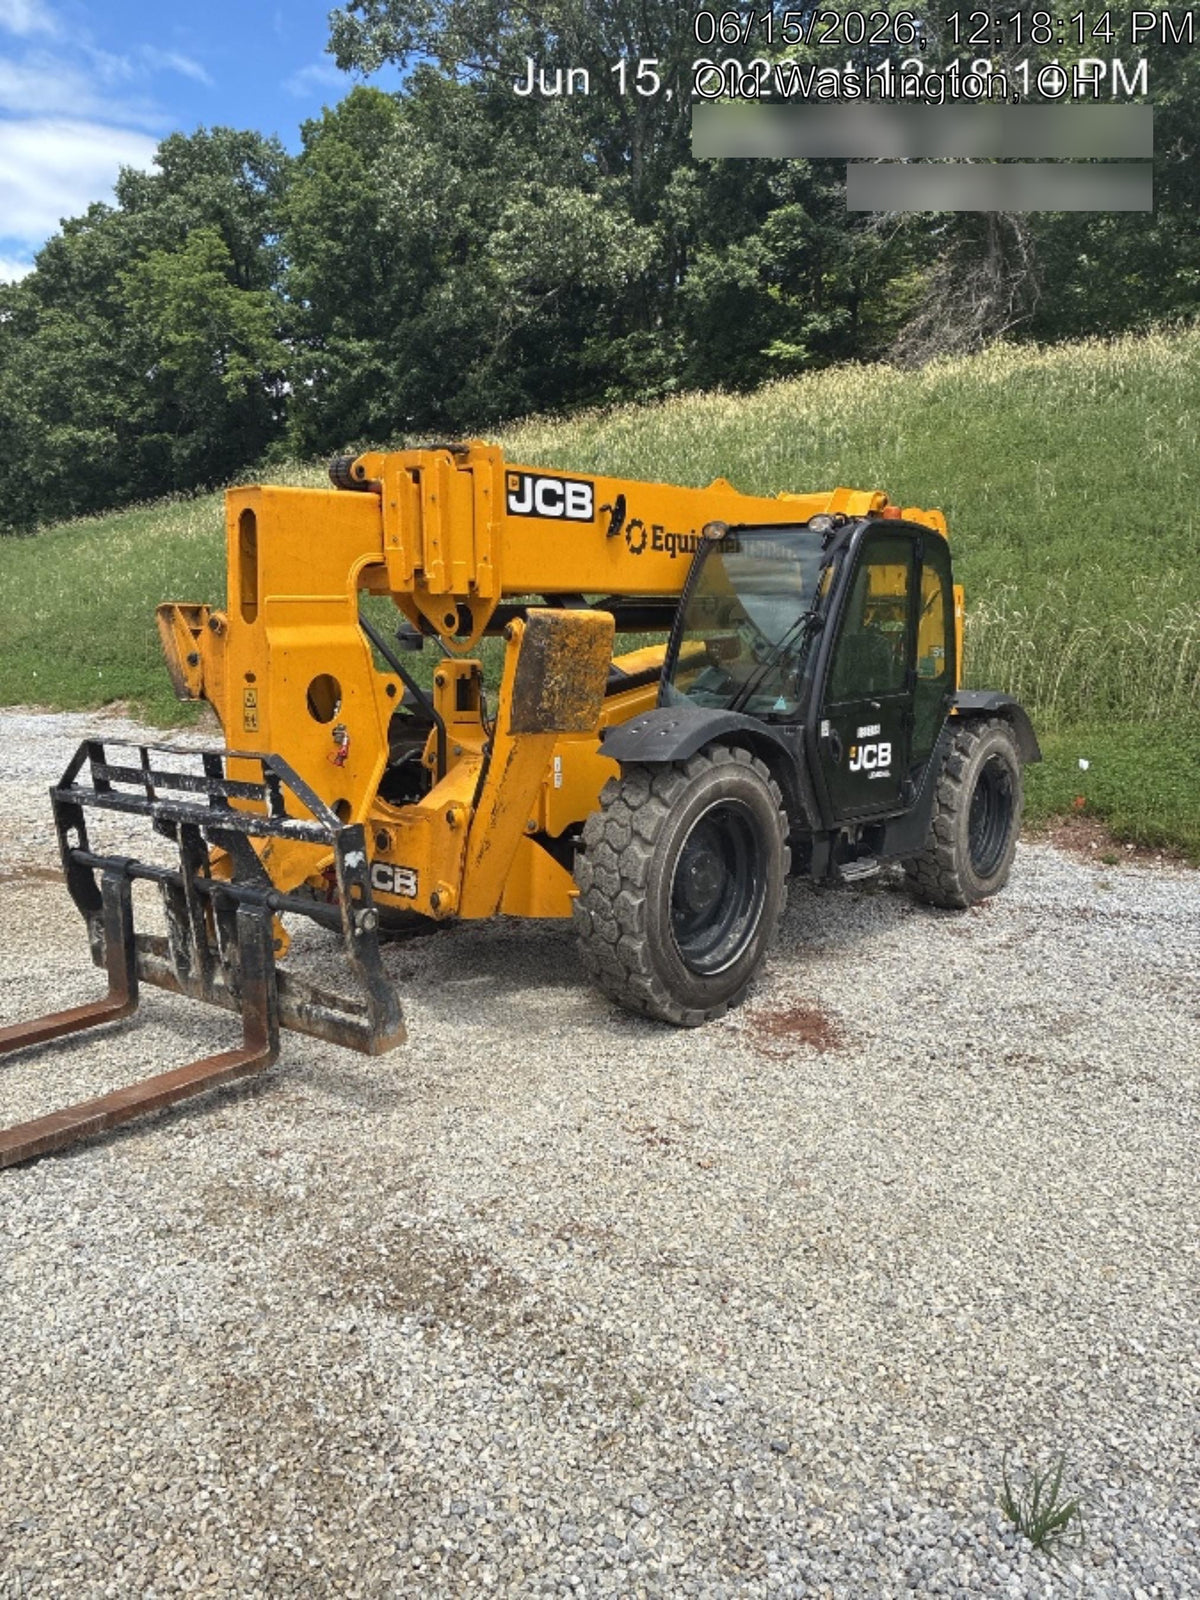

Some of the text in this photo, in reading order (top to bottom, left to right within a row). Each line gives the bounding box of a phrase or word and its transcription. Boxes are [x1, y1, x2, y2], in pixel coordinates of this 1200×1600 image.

[507, 475, 595, 520] JCB
[849, 742, 892, 772] JCB
[370, 862, 418, 898] CB
